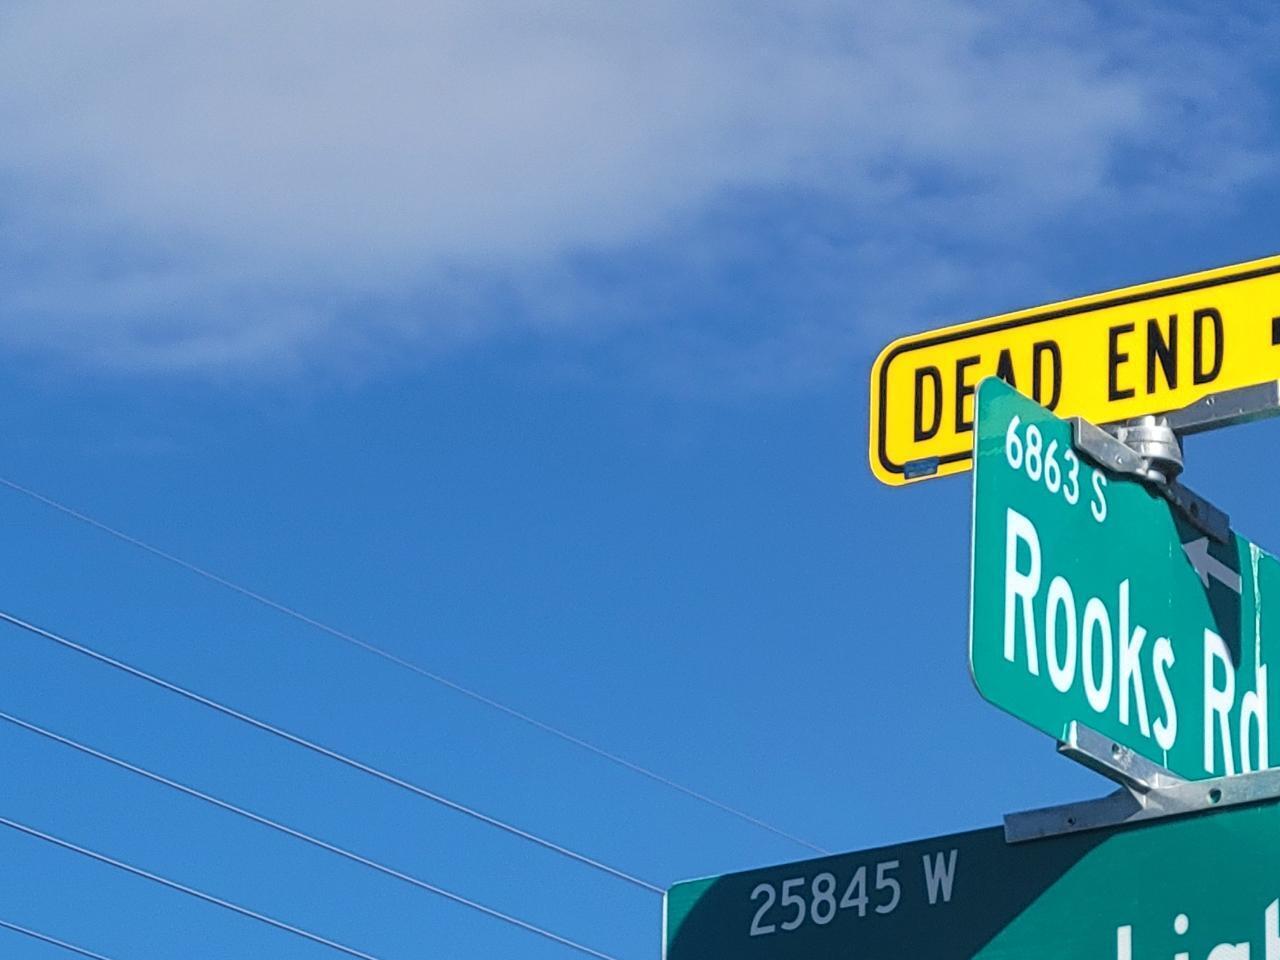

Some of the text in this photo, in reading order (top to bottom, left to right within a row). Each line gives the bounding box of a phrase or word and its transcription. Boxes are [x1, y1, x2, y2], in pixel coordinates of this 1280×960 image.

[1108, 307, 1225, 401] END
[1005, 415, 1107, 523] 6863 S
[1003, 507, 1269, 777] Rooks Rd
[749, 849, 958, 937] 25845 W
